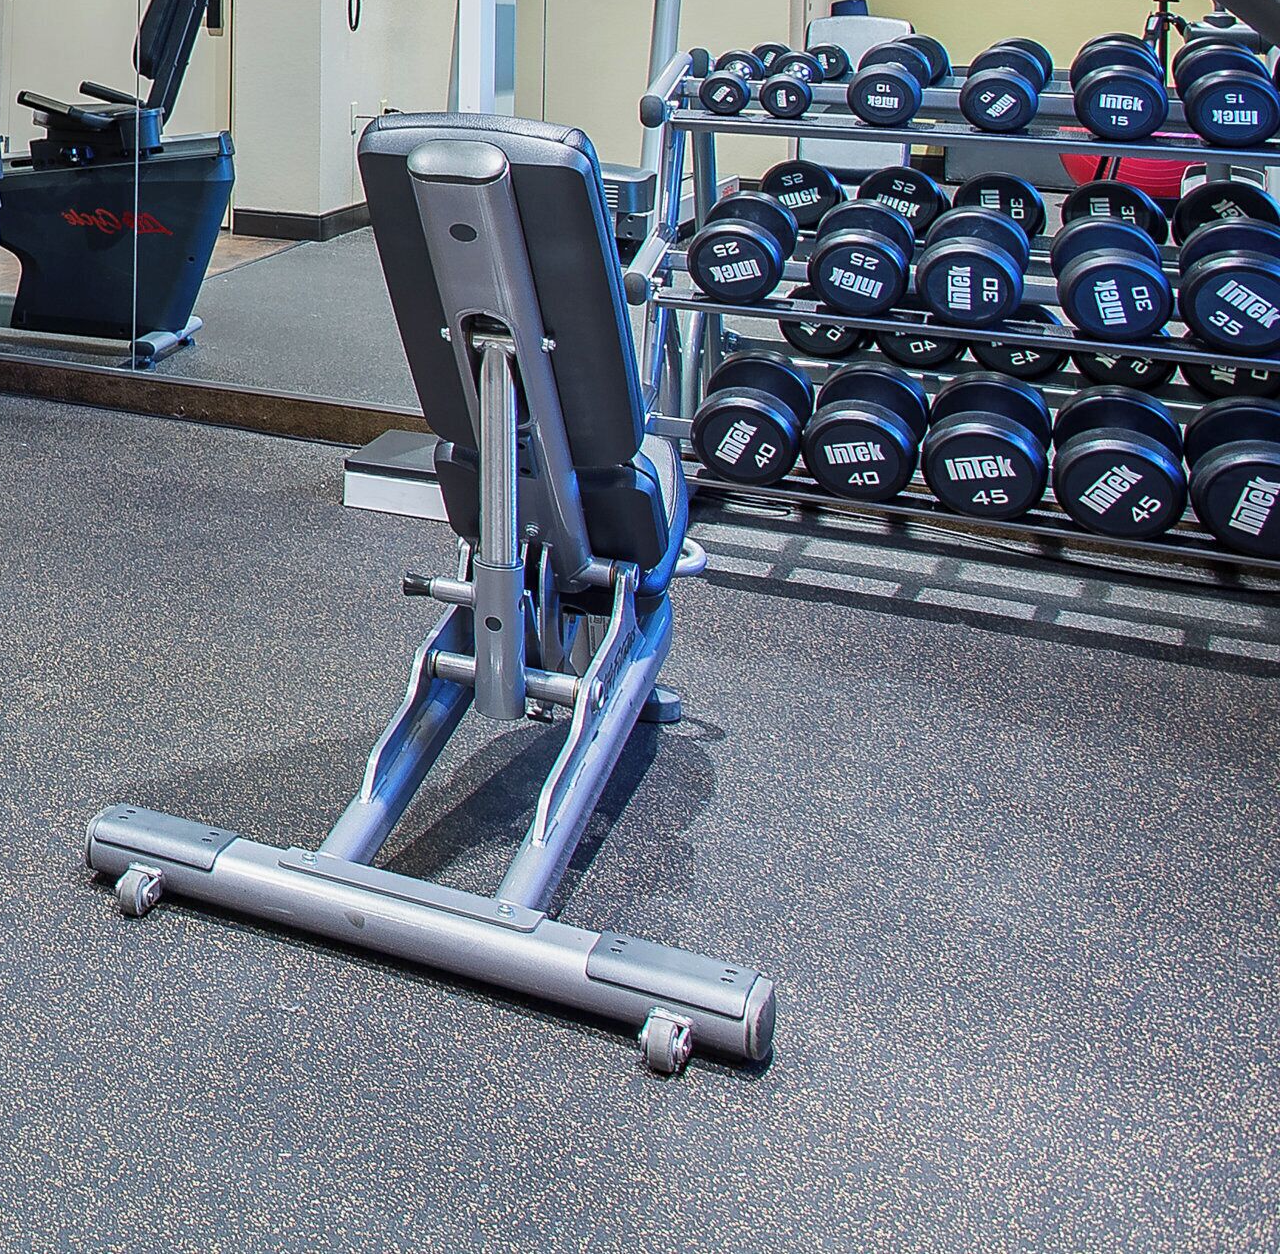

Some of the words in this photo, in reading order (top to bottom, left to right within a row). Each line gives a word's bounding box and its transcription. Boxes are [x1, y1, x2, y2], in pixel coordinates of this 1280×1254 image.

[876, 84, 890, 93] 10
[980, 91, 995, 103] 10
[1225, 93, 1245, 104] 15
[1110, 115, 1129, 126] 15
[712, 241, 740, 258] 25
[850, 252, 880, 270] 25
[982, 278, 999, 302] 30
[1131, 286, 1153, 312] 30
[1208, 310, 1244, 336] 35
[754, 442, 777, 468] 40
[848, 471, 880, 486] 40
[971, 489, 1009, 505] 45
[1130, 495, 1162, 523] 45
